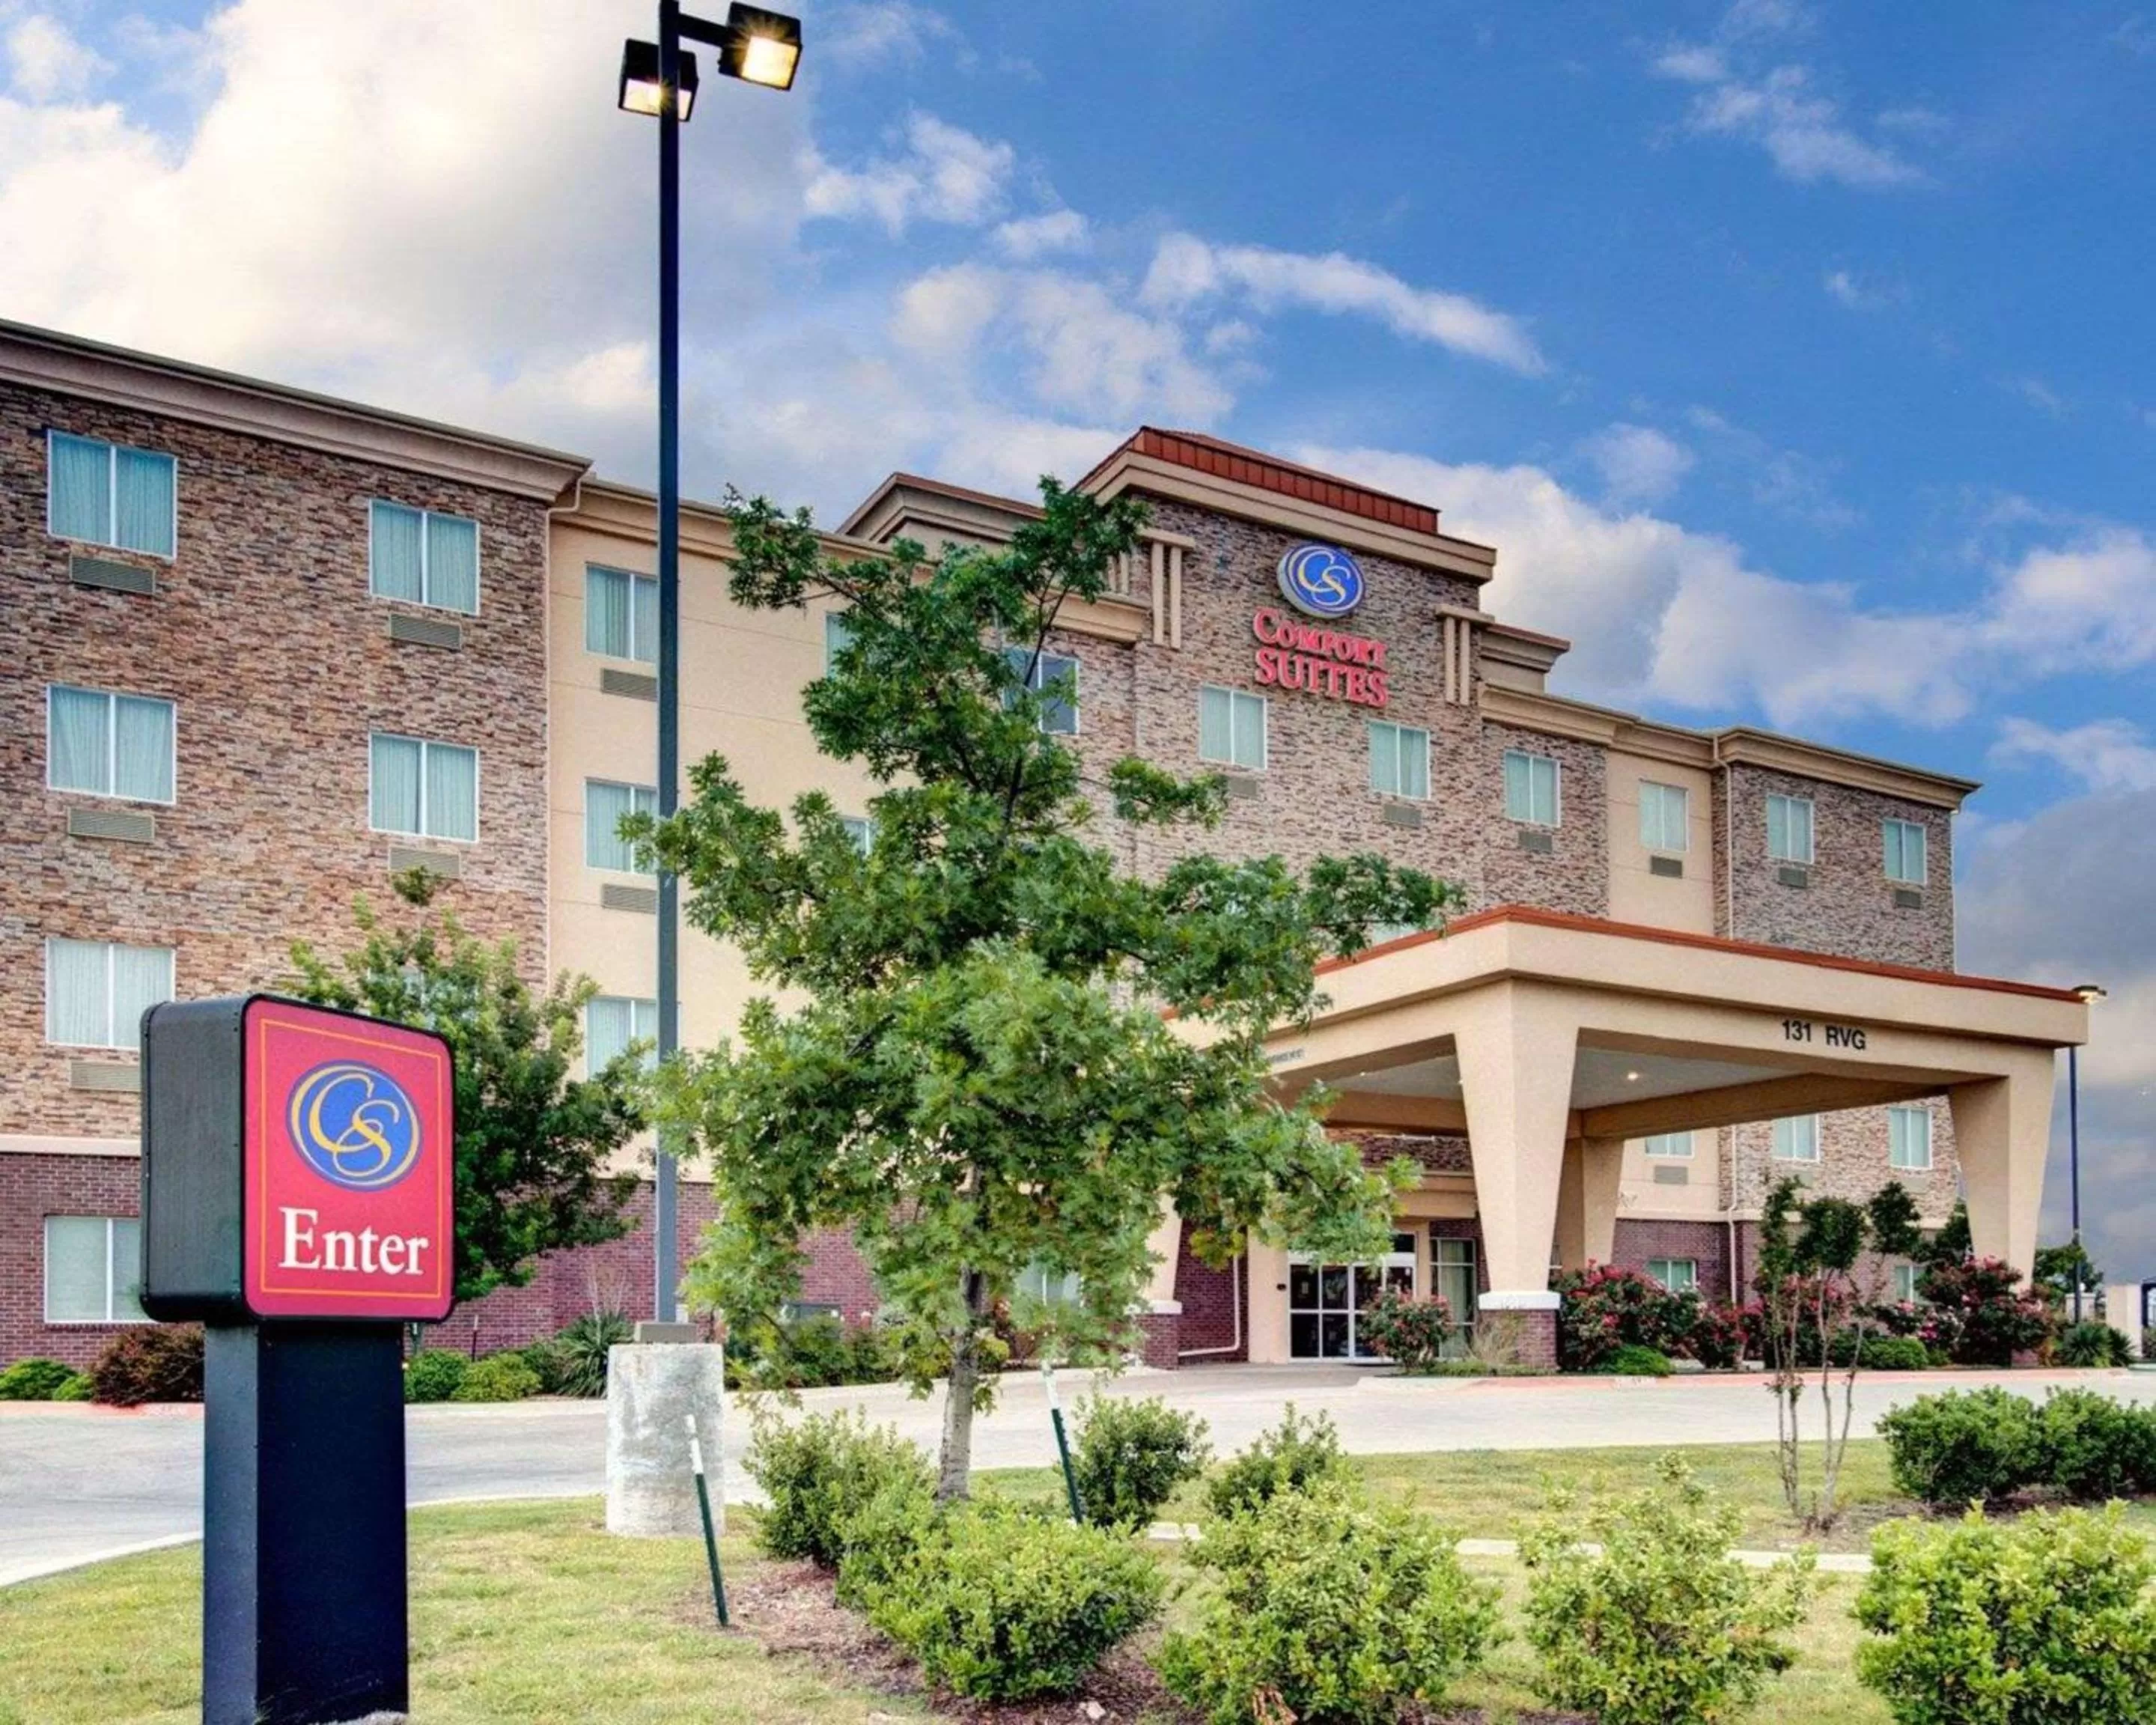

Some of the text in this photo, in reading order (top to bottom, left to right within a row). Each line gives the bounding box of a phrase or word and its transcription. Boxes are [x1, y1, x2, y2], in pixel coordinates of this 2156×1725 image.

[1255, 648, 1389, 708] SUITES
[1782, 1019, 1866, 1050] 131 RVG
[278, 1207, 429, 1275] Enter
